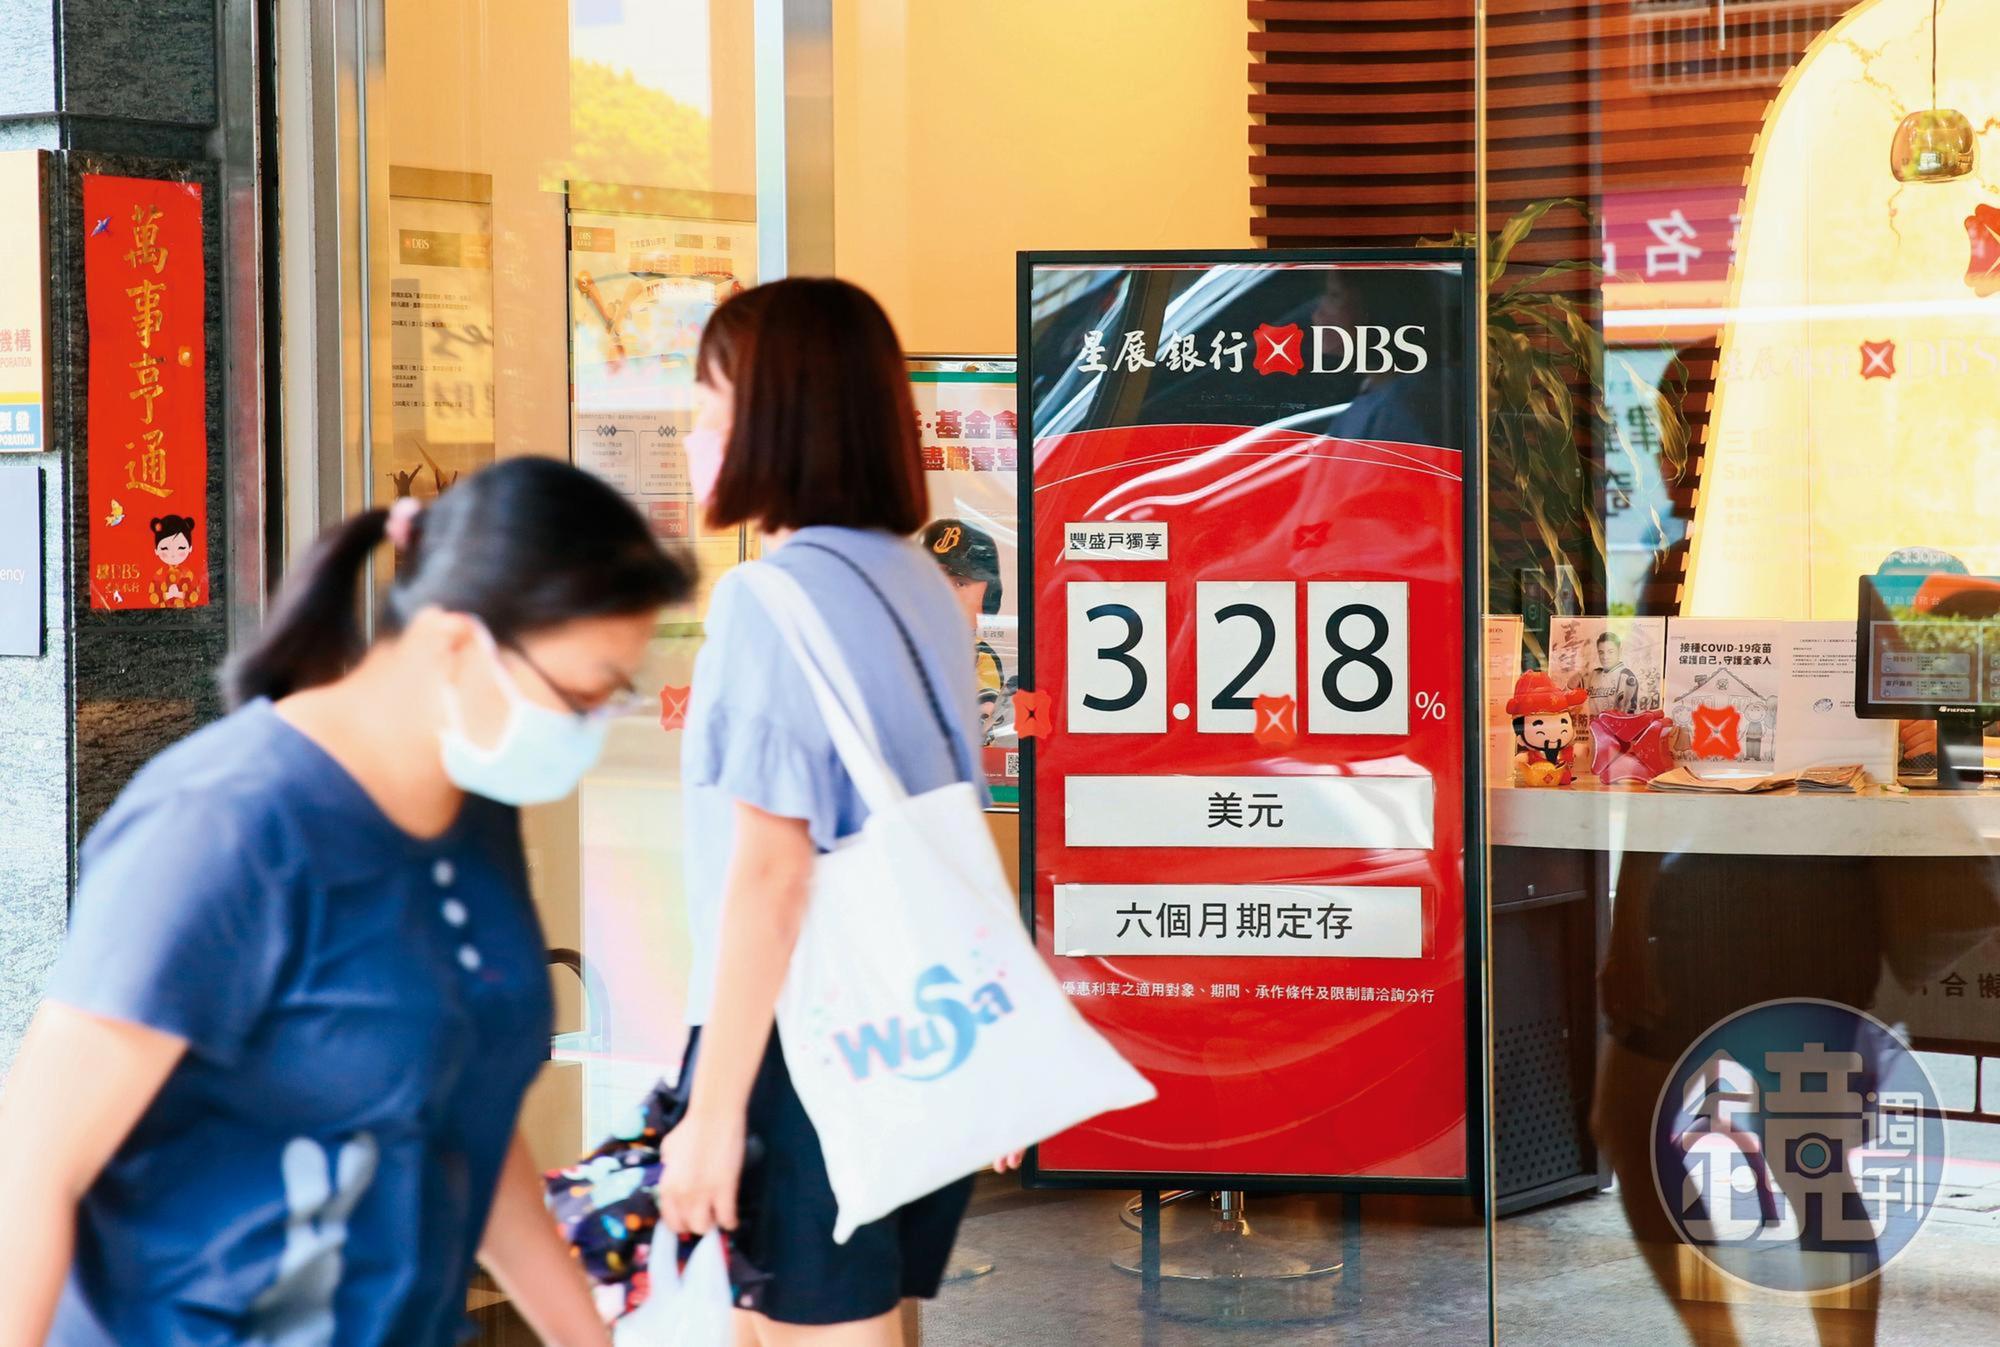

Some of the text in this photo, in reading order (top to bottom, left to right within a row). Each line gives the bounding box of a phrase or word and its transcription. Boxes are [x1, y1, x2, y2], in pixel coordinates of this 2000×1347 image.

[123, 203, 174, 498] 萬事亨通
[1076, 330, 1247, 374] 星展銀行
[1310, 325, 1429, 375] DBS
[914, 409, 1017, 439] ·基金會
[1680, 643, 1773, 654] 接種COVID-19疫苗
[1206, 791, 1284, 829] 美元
[1115, 901, 1354, 940] 六個月期定存
